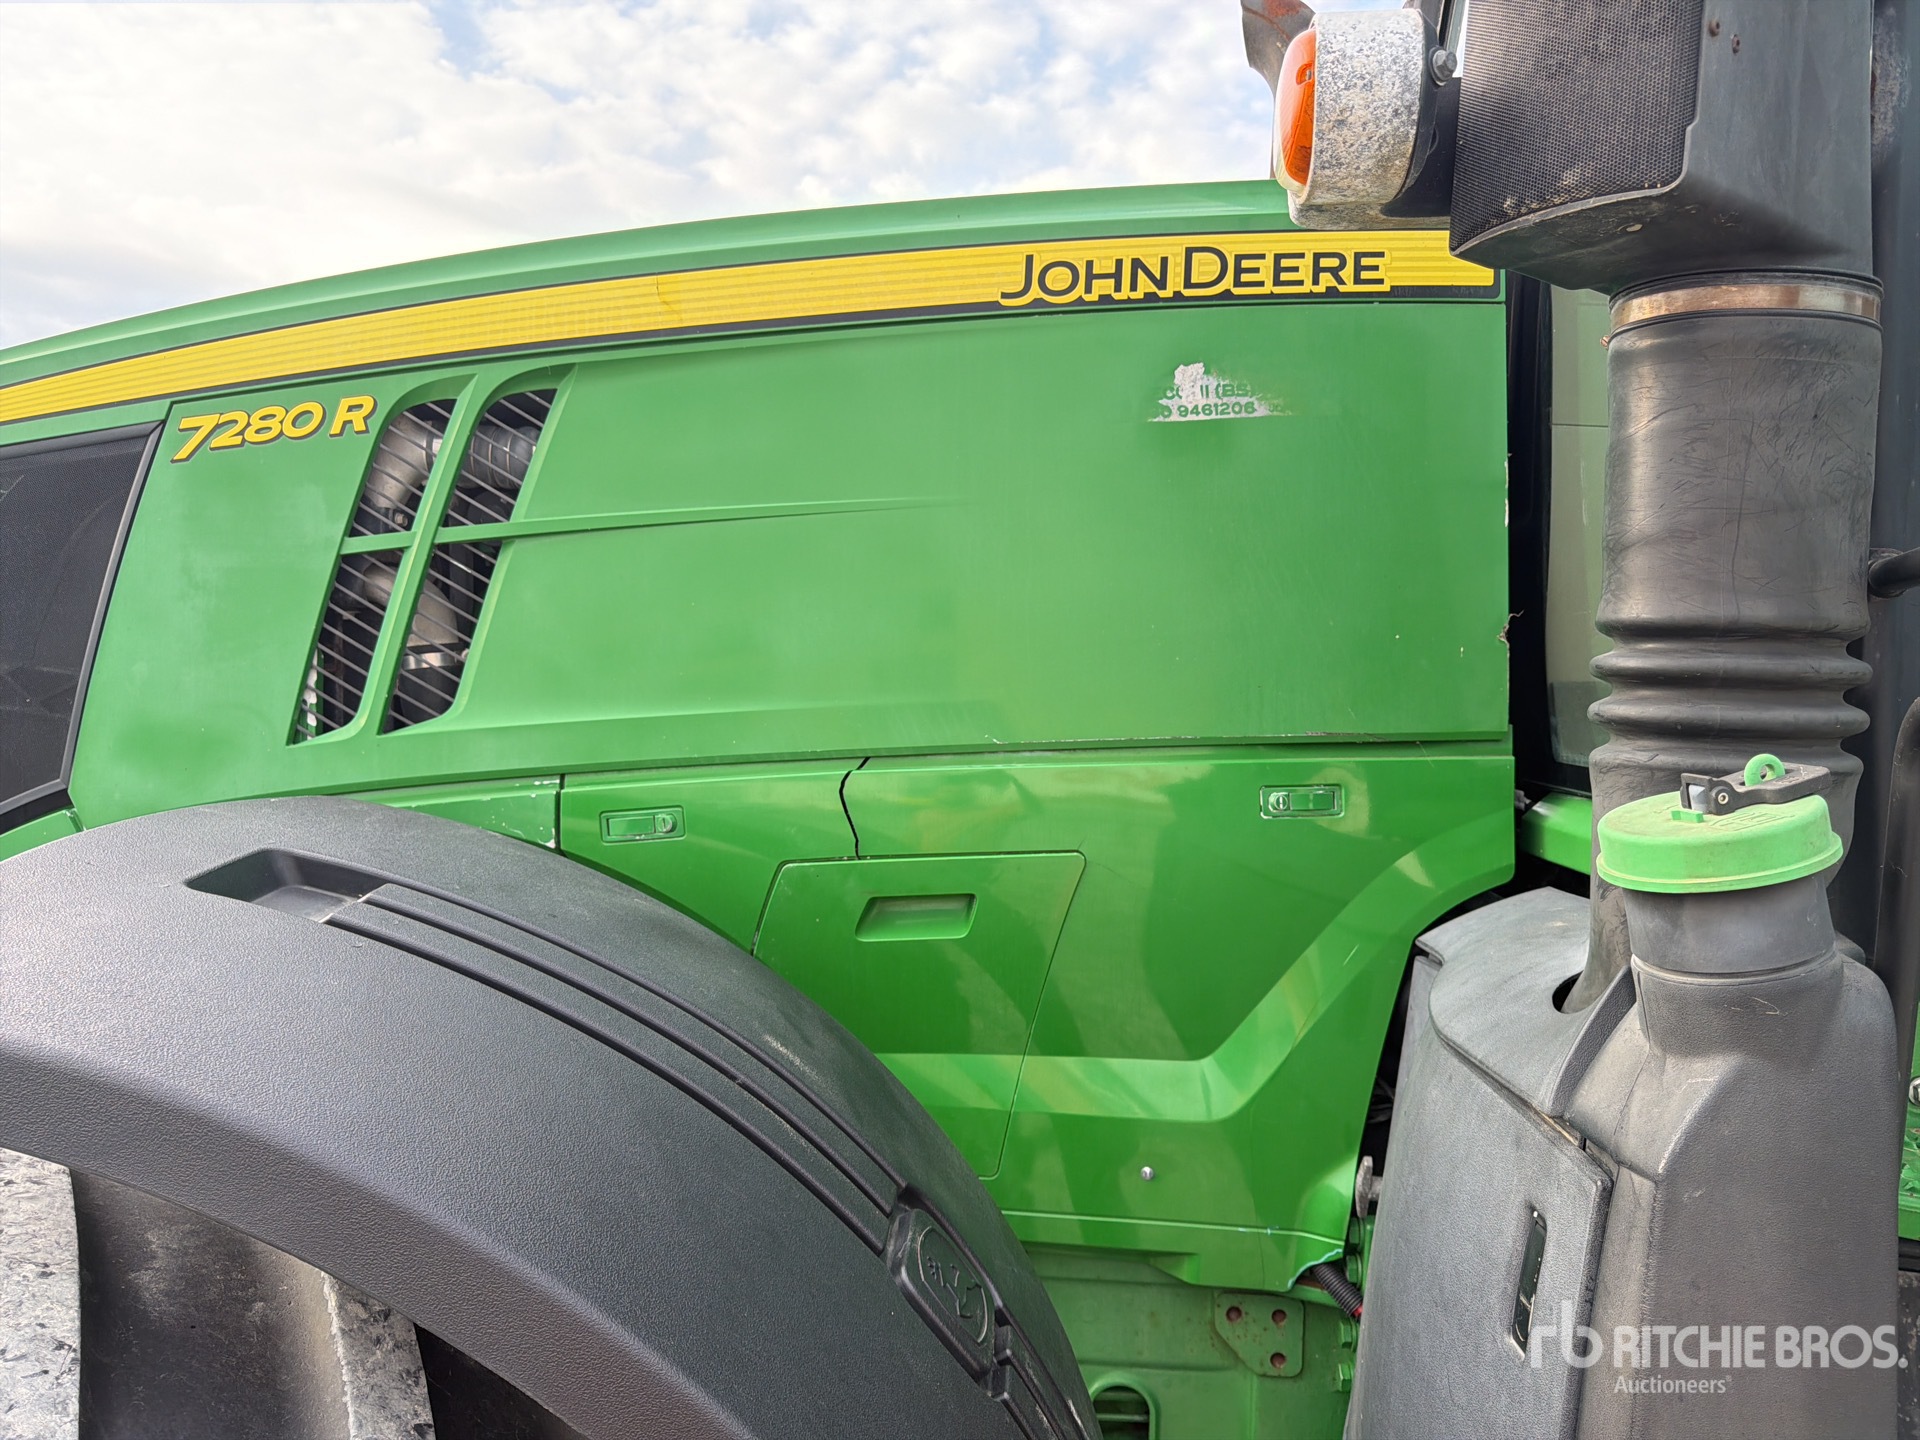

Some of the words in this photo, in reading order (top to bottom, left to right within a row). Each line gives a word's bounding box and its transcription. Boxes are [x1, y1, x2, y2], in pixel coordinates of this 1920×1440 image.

[1000, 253, 1169, 301] JOHN
[1184, 247, 1386, 292] DEERE
[171, 401, 325, 463] 7280
[329, 395, 377, 438] R
